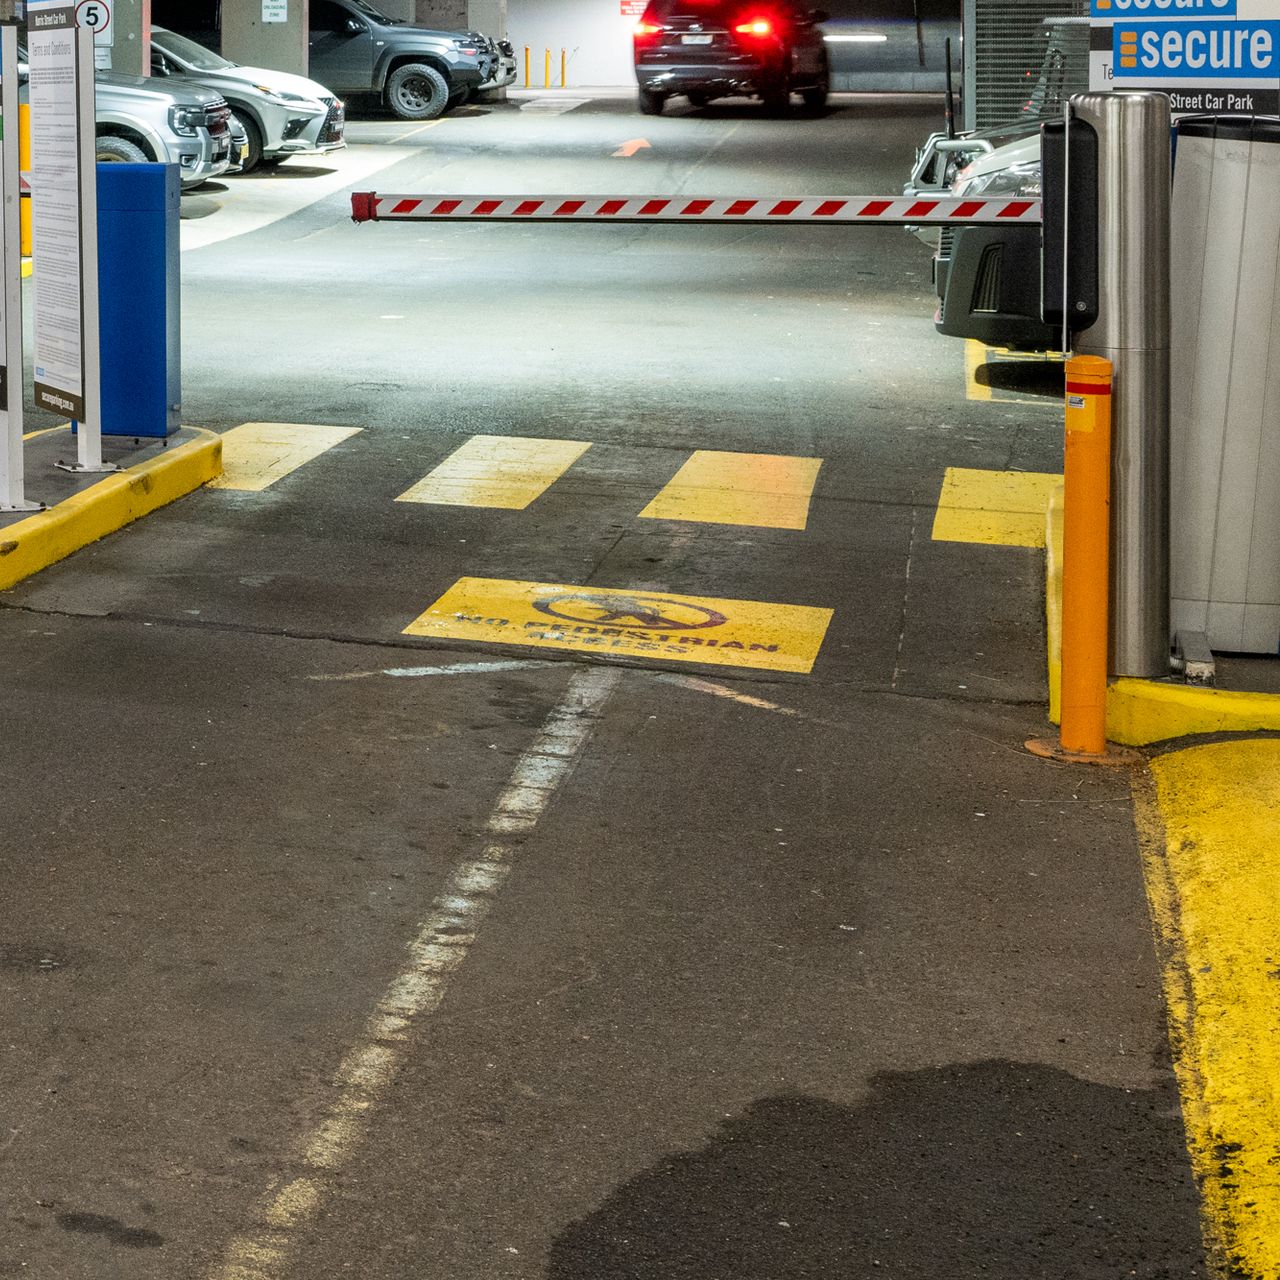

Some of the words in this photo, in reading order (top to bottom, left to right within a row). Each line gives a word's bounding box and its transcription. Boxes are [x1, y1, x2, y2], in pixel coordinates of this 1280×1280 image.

[86, 7, 99, 26] 5
[1141, 28, 1273, 69] secure
[1170, 93, 1202, 109] Street
[1205, 94, 1224, 109] Car
[1227, 94, 1253, 110] Park
[524, 621, 779, 653] PEDESTRIAN
